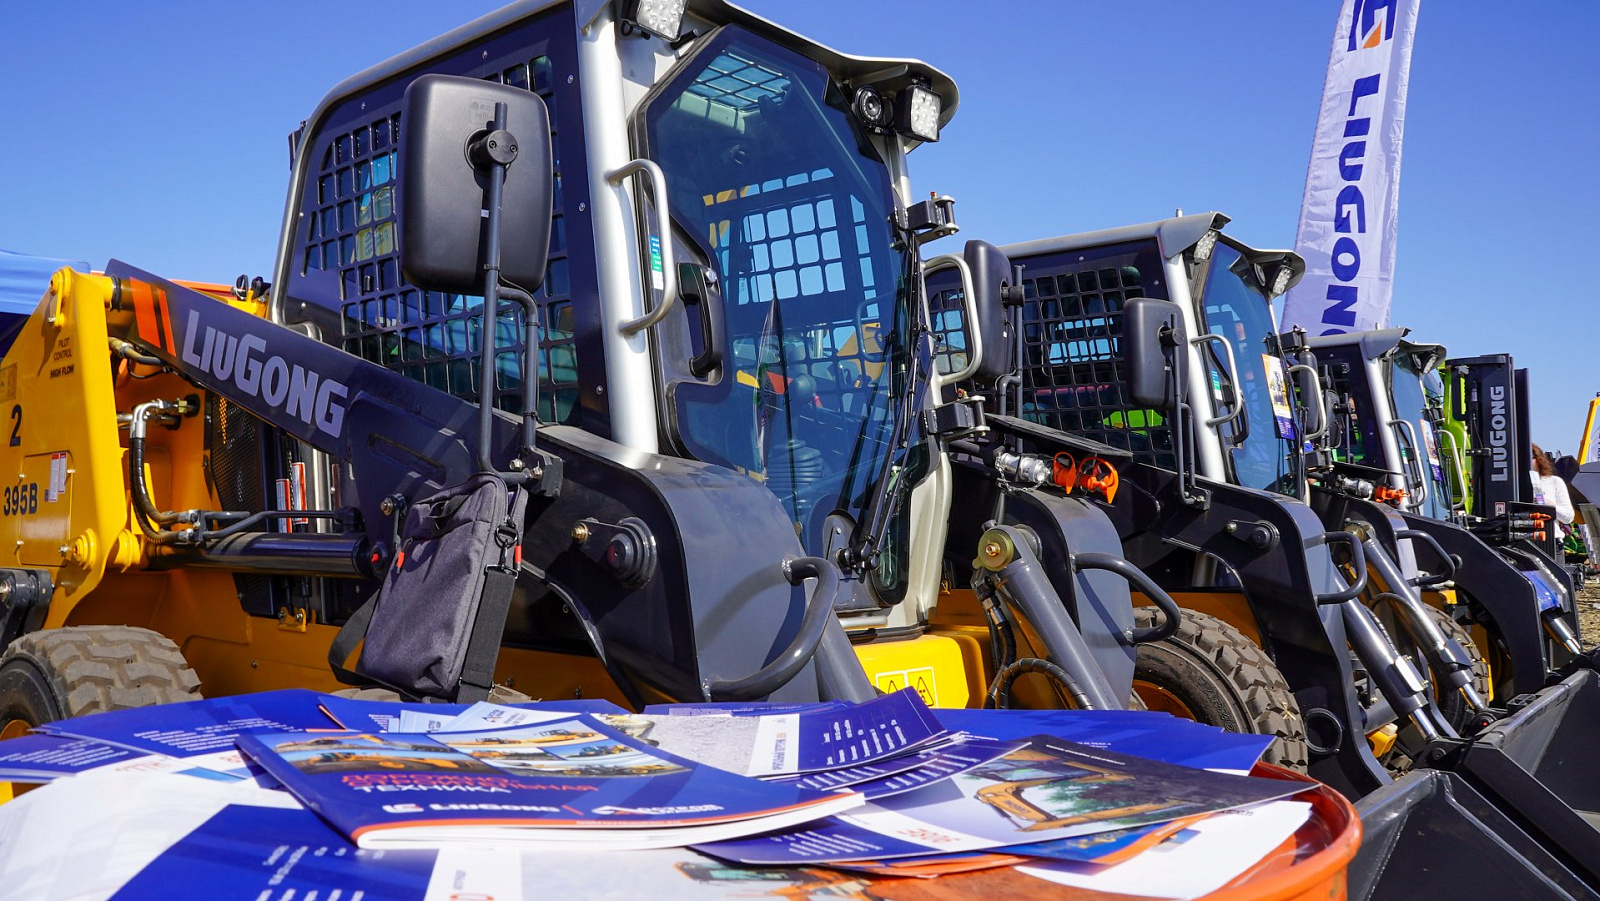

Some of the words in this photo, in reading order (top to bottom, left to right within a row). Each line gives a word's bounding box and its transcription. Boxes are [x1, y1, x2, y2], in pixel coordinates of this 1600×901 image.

[1320, 73, 1381, 336] LIUGON
[58, 337, 70, 348] PILOT
[54, 349, 72, 361] CONTROL
[50, 368, 62, 379] HIGH
[62, 364, 75, 375] FLOW
[9, 404, 22, 447] 2
[1489, 385, 1508, 482] LIUGONG
[3, 482, 38, 516] 395B
[353, 785, 512, 793] ТЕХНИКА
